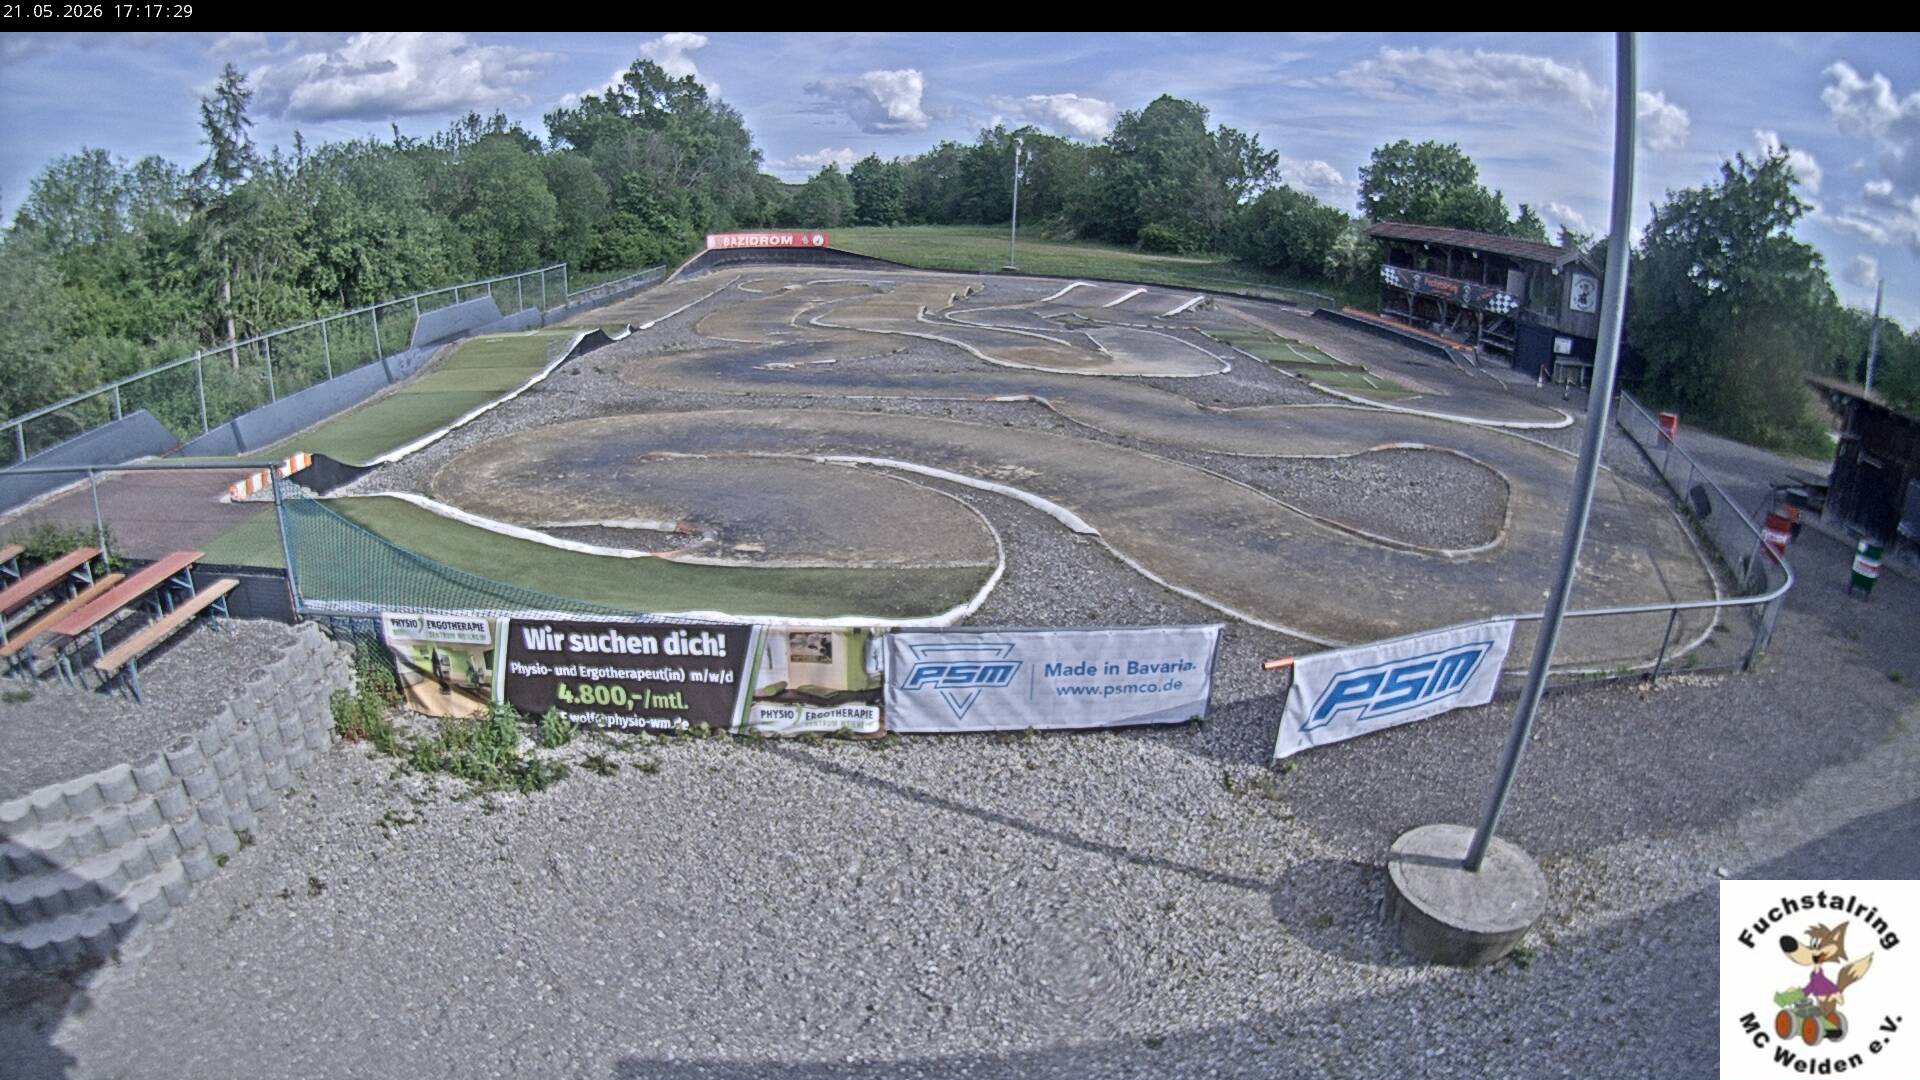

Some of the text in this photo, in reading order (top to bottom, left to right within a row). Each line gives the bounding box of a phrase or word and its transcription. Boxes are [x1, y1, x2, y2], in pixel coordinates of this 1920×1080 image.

[723, 235, 794, 247] BAZIDROM
[426, 619, 485, 632] ERGOTHERAPIE
[522, 625, 727, 657] Wir suchen dich!
[510, 661, 734, 684] Physio- und Ergotherapeut(in) m/w/d
[909, 664, 1016, 685] PSM
[1044, 658, 1197, 678] Made in Bavaria.
[1056, 679, 1183, 698] www.psmco.de
[1311, 649, 1484, 722] PSM
[760, 708, 874, 721] PHYSIO ERGOTHERAPIE
